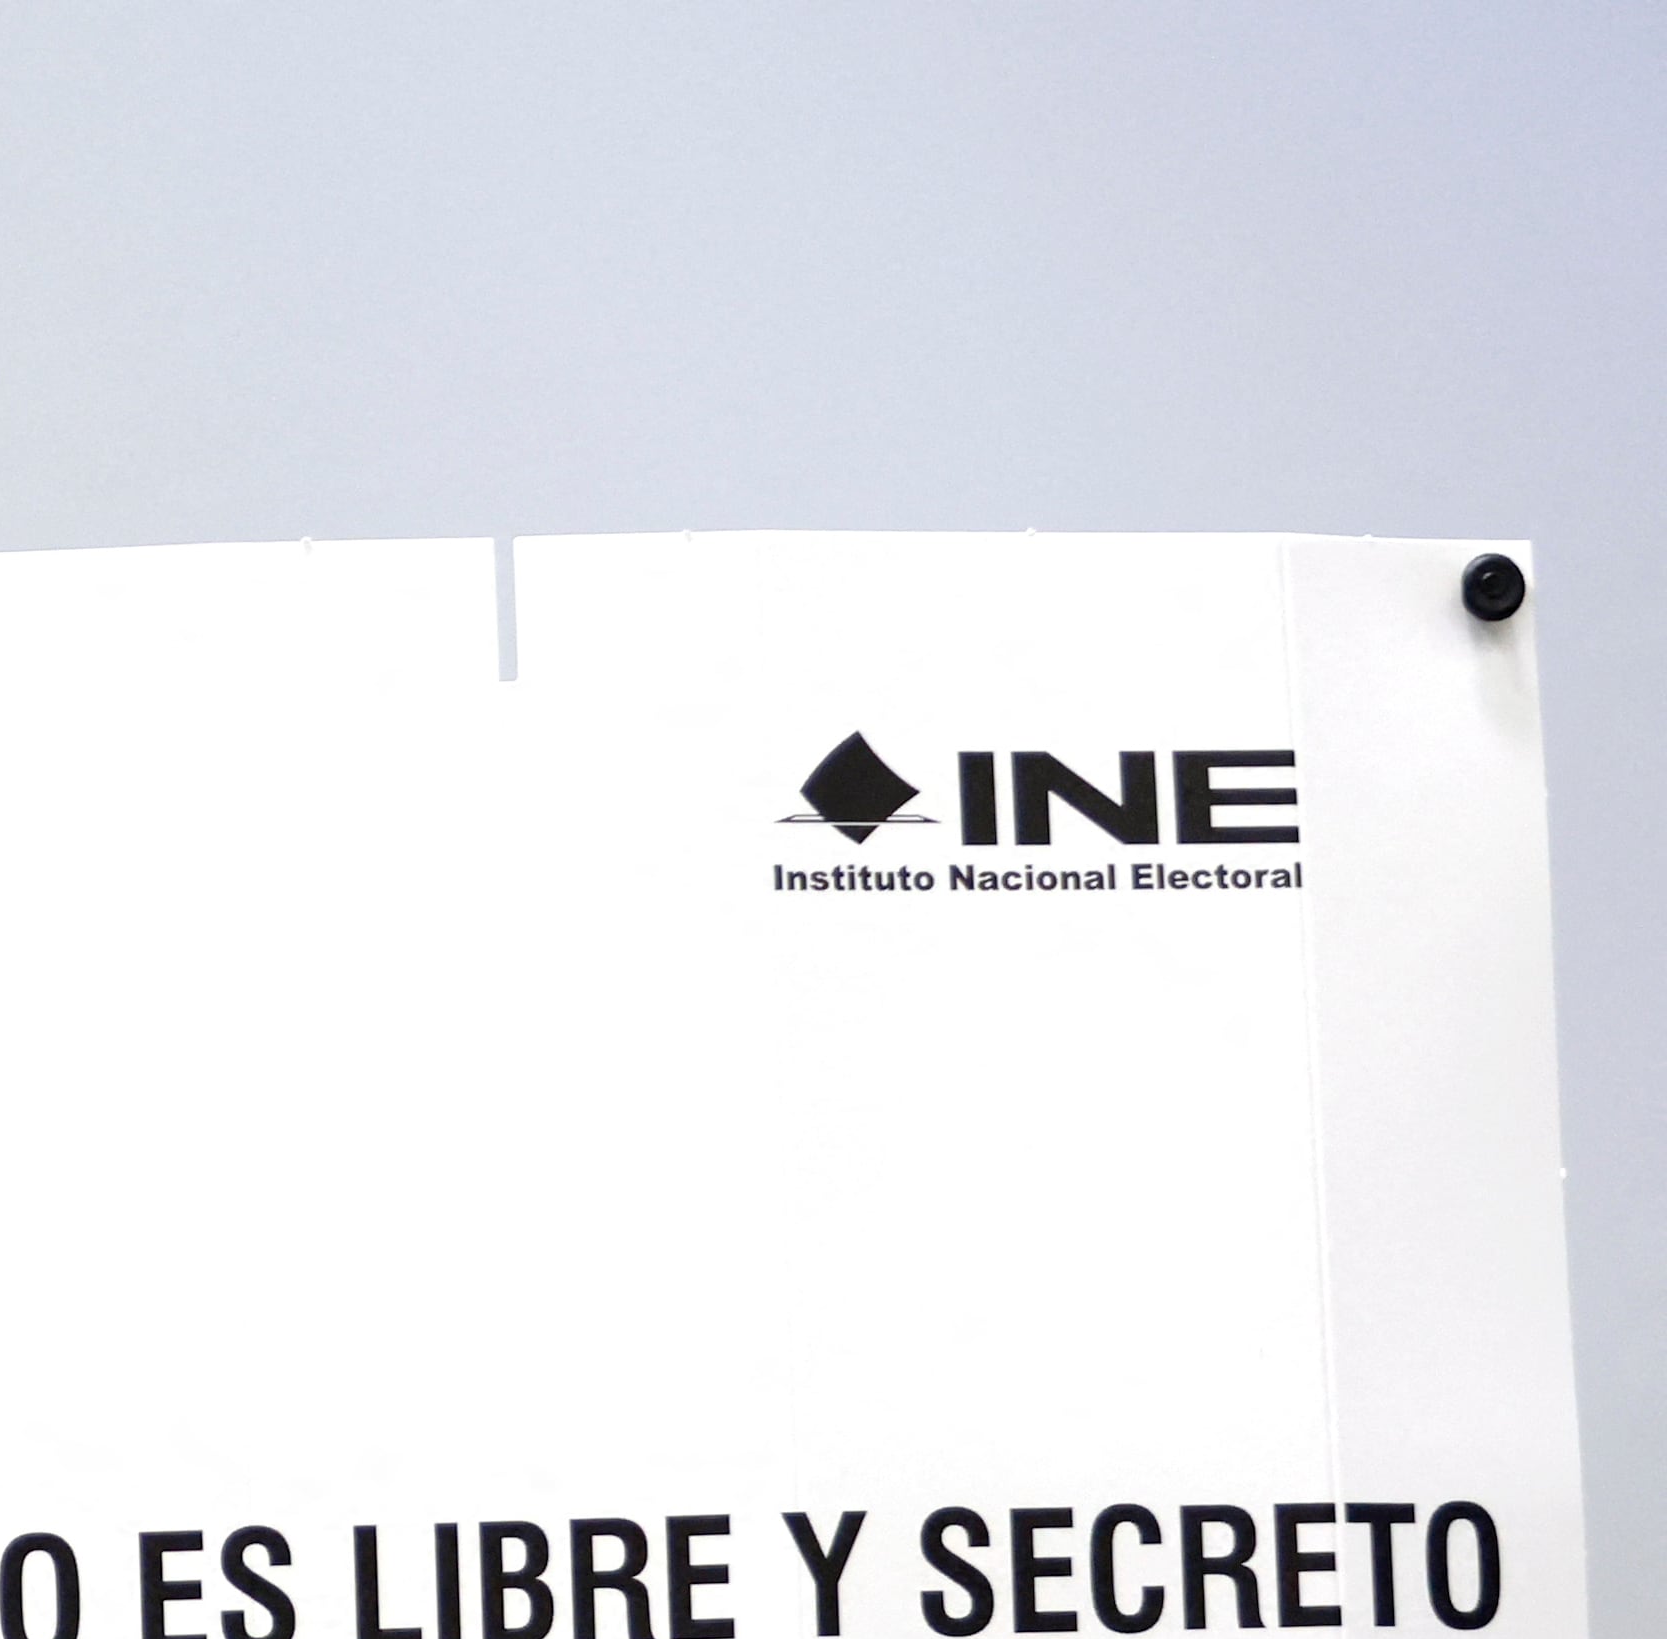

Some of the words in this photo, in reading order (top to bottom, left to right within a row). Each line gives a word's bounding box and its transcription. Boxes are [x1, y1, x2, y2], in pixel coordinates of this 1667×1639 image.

[957, 749, 1300, 846] INE
[773, 864, 935, 891] Instituto
[949, 863, 1116, 891] Nacional
[1131, 861, 1303, 890] Electoral
[780, 1510, 868, 1637] Y
[919, 1500, 1501, 1638] SECRETO
